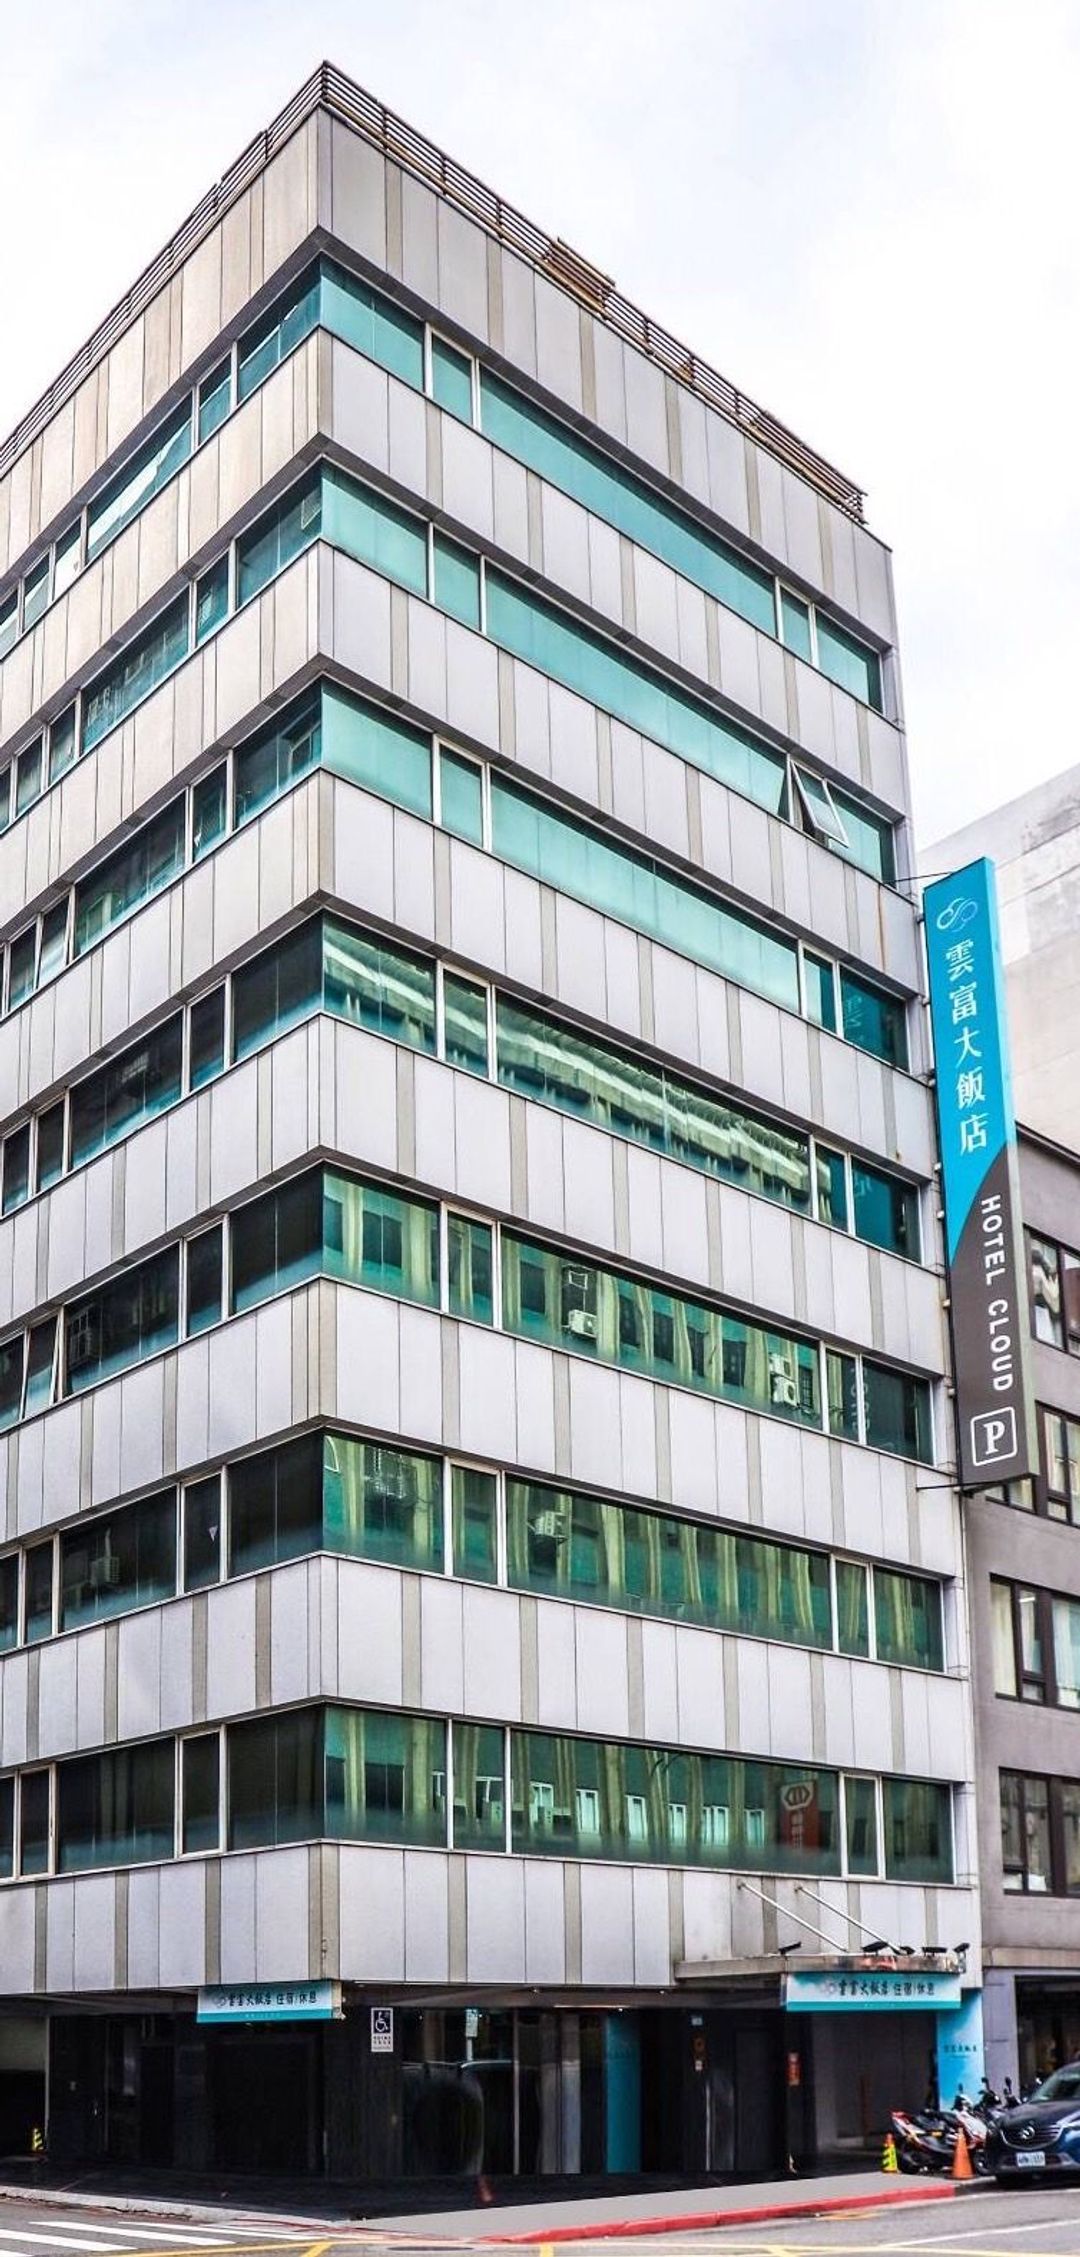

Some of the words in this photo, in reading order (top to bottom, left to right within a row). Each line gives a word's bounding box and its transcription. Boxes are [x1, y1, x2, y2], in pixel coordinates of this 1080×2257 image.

[944, 938, 990, 1156] 雲富大飯店
[980, 1194, 1006, 1287] HOTEL
[987, 1298, 1014, 1392] CLOUD
[983, 1418, 1006, 1456] P
